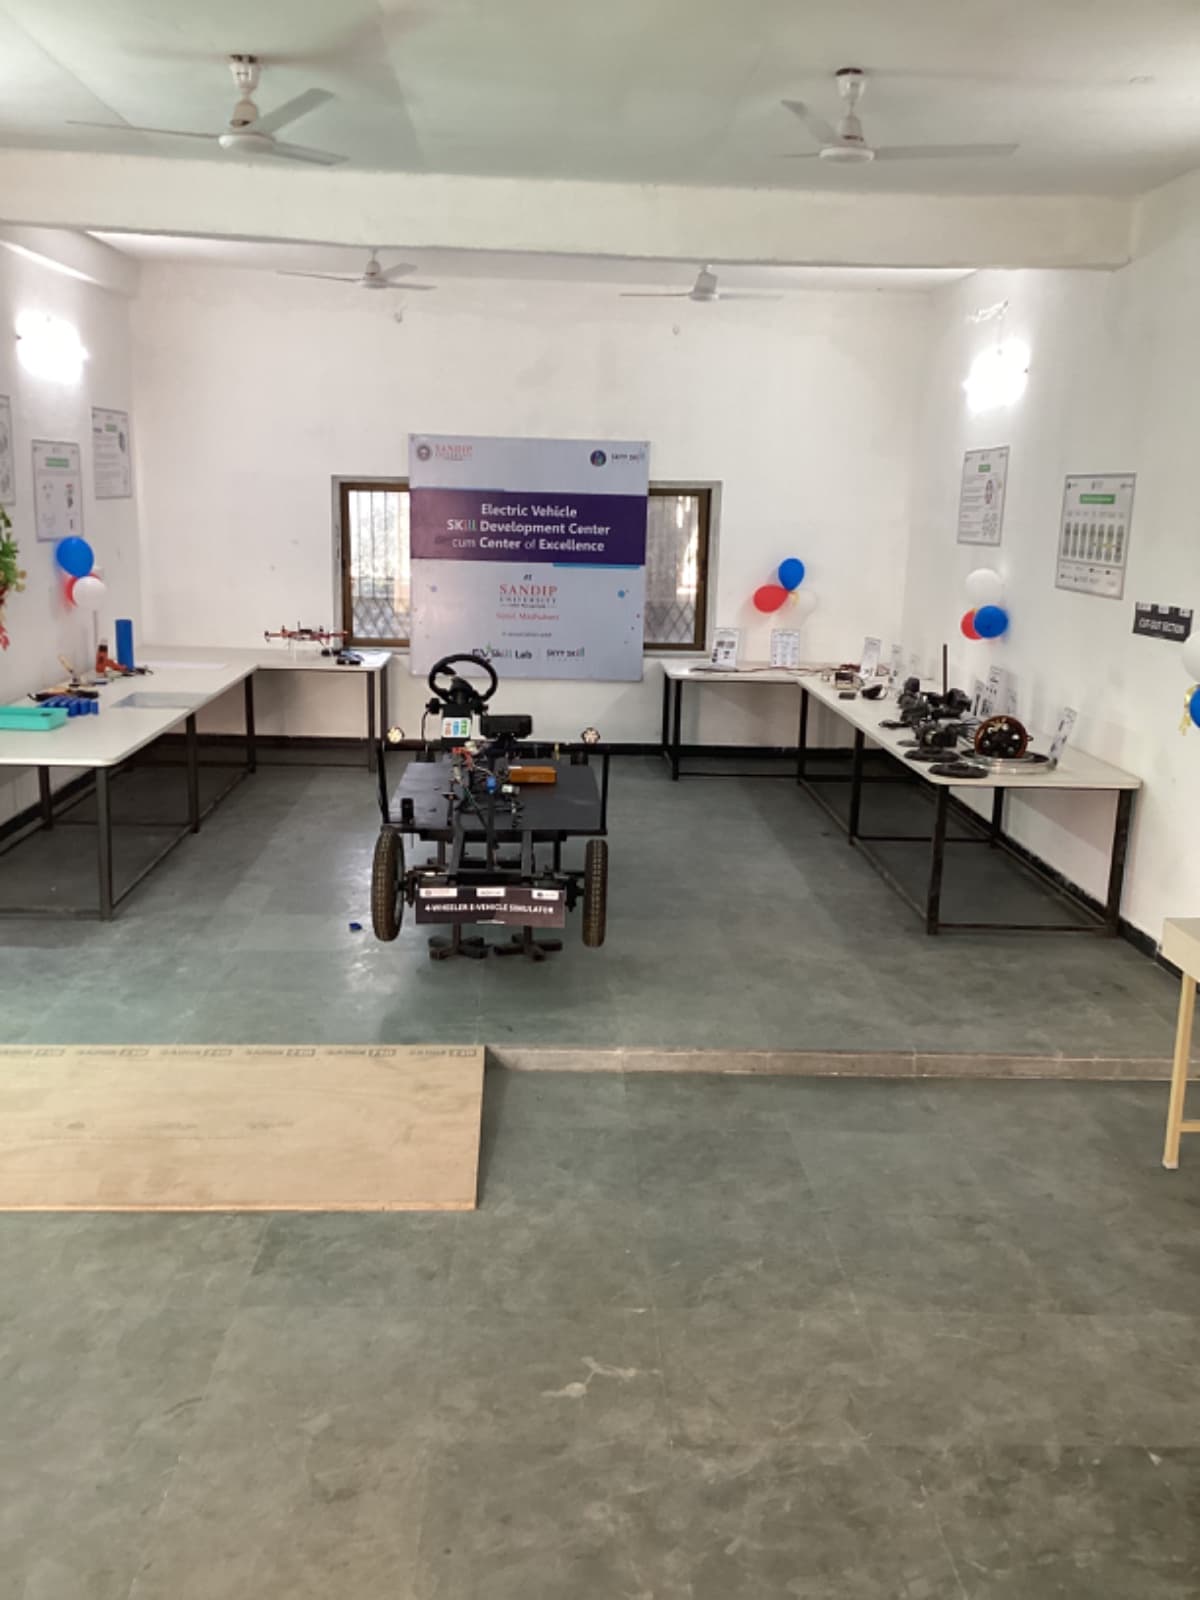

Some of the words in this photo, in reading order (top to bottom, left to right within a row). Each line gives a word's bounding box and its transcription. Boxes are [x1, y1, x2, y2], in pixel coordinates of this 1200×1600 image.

[481, 503, 528, 517] Electric
[531, 505, 578, 518] Vehicle
[480, 520, 565, 536] Development
[568, 523, 611, 536] Center
[452, 538, 476, 549] cum
[479, 537, 521, 550] Center
[524, 539, 537, 550] of
[539, 539, 605, 552] Excellence
[499, 584, 558, 597] SANDIP
[515, 649, 533, 660] Lab
